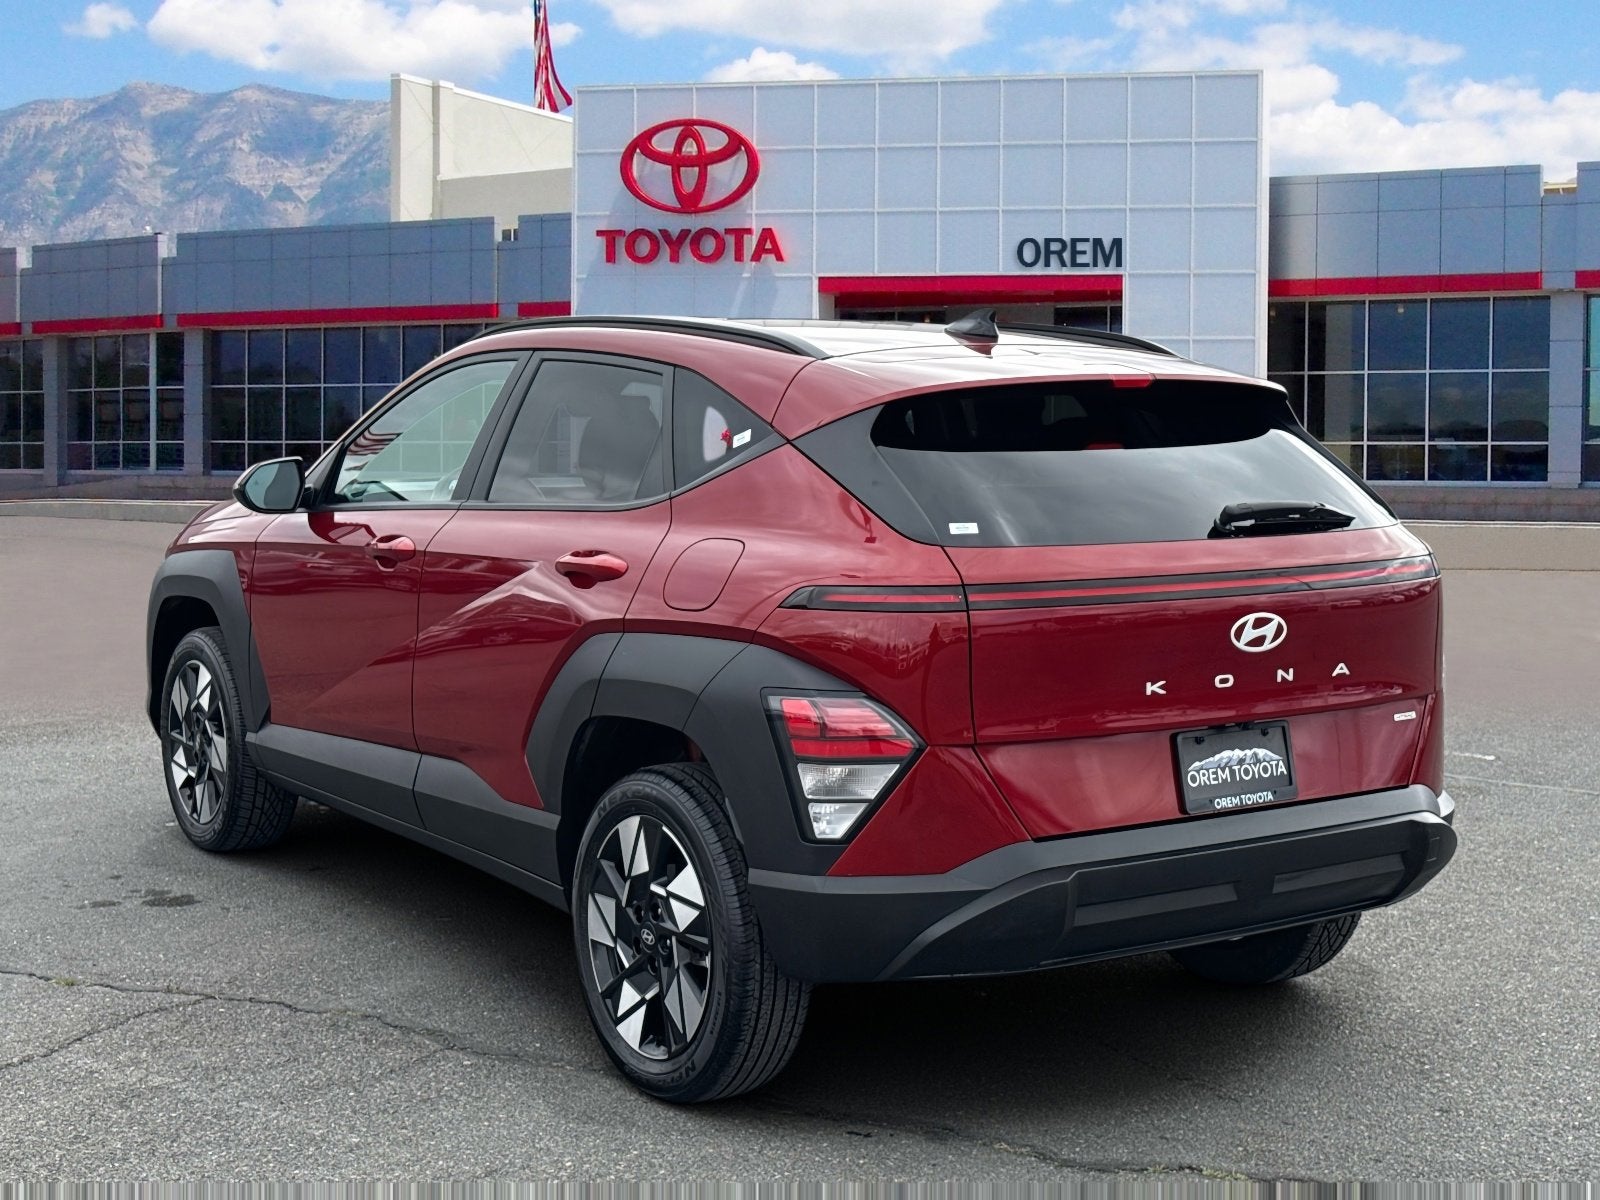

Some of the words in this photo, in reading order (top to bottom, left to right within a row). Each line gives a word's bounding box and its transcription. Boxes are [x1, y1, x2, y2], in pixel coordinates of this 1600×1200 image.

[596, 227, 785, 264] TOYOTA
[1017, 237, 1123, 268] OREM
[1145, 662, 1350, 695] KONA
[1187, 767, 1231, 788] OREM
[1232, 760, 1287, 782] TOYOTA
[1214, 796, 1240, 809] OREM
[1241, 790, 1274, 806] TOYOTA
